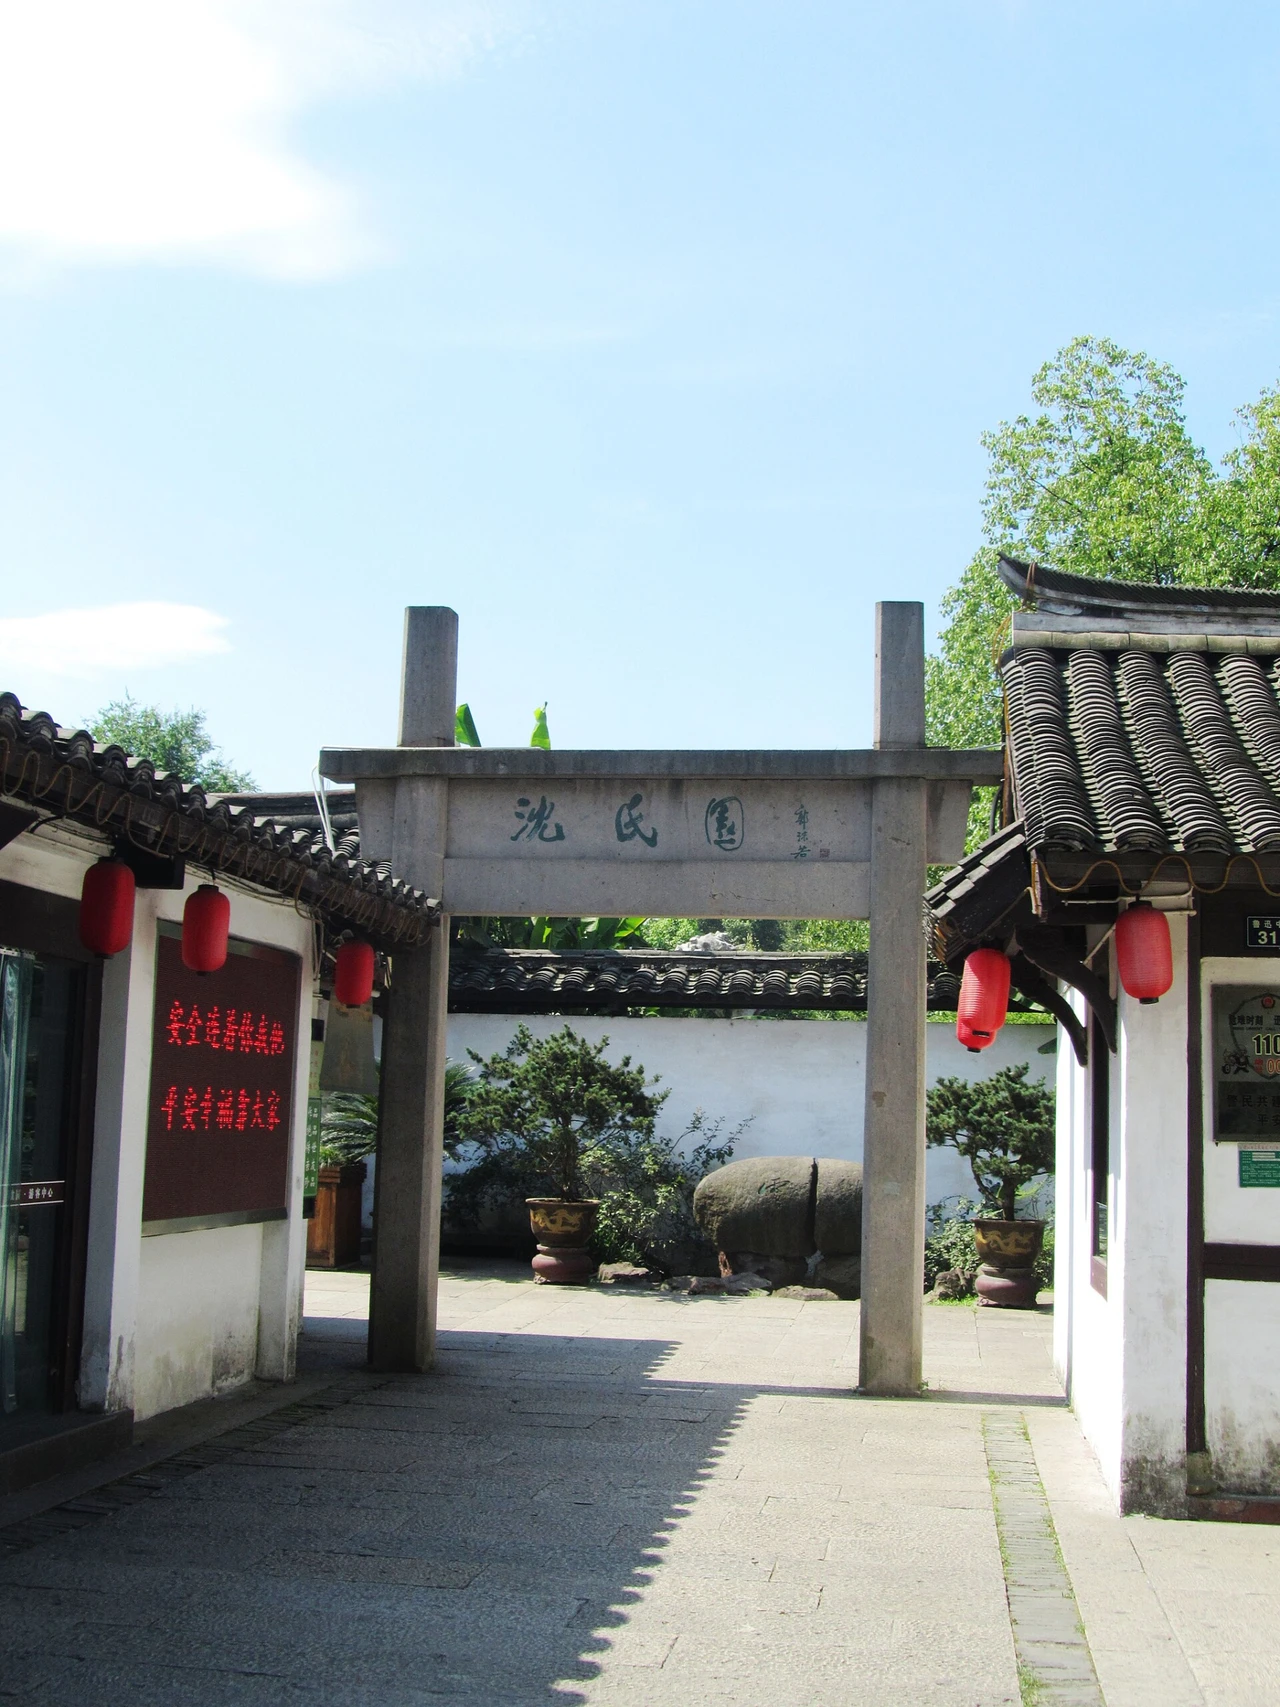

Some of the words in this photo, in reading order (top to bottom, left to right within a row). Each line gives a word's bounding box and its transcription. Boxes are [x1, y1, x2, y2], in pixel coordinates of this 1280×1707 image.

[1258, 931, 1276, 944] 31
[161, 1086, 280, 1130] 平安幸福靠大家
